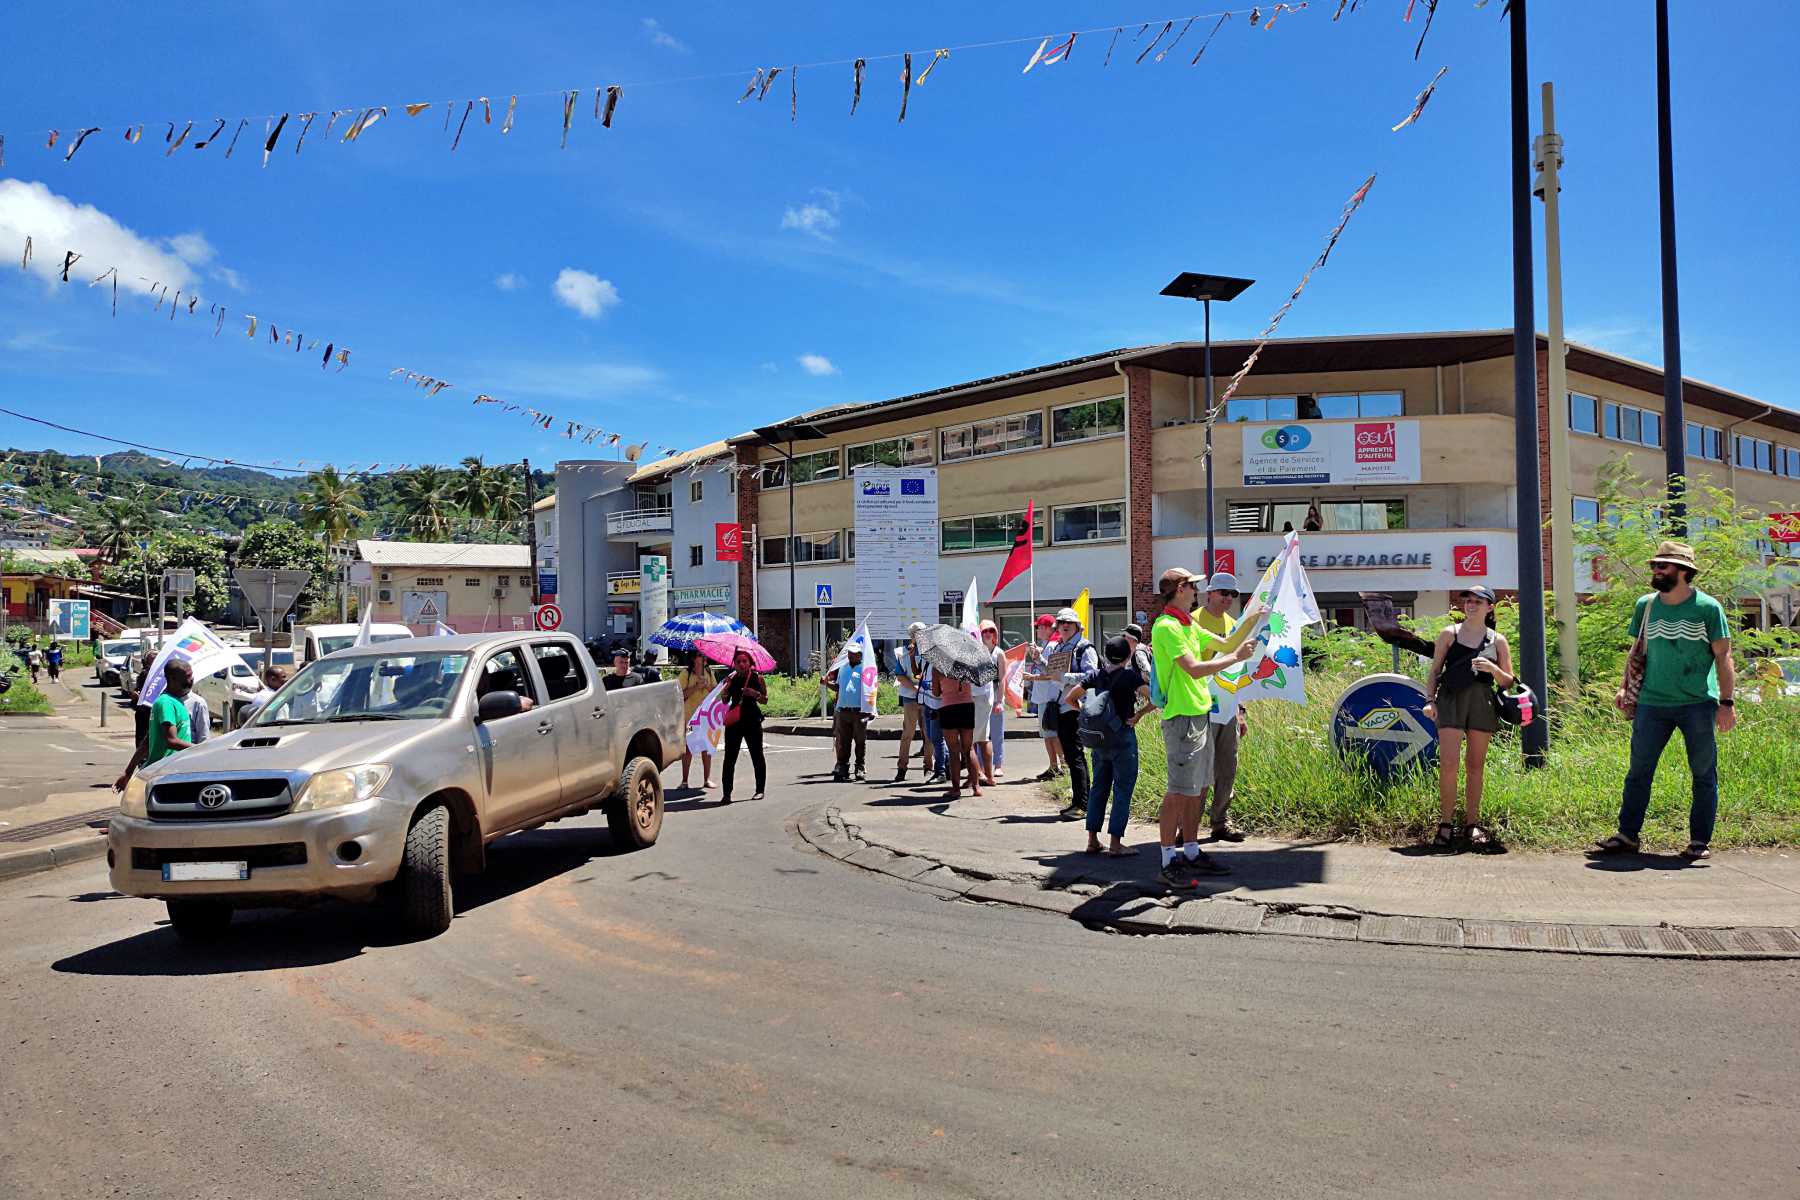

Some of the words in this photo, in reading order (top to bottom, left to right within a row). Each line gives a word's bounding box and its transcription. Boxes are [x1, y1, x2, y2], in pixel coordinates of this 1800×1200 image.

[1249, 457, 1277, 466] Agence
[1326, 553, 1432, 567] D'EPARGNE
[680, 588, 724, 600] PHARMACIE
[1364, 712, 1396, 727] YACCO
